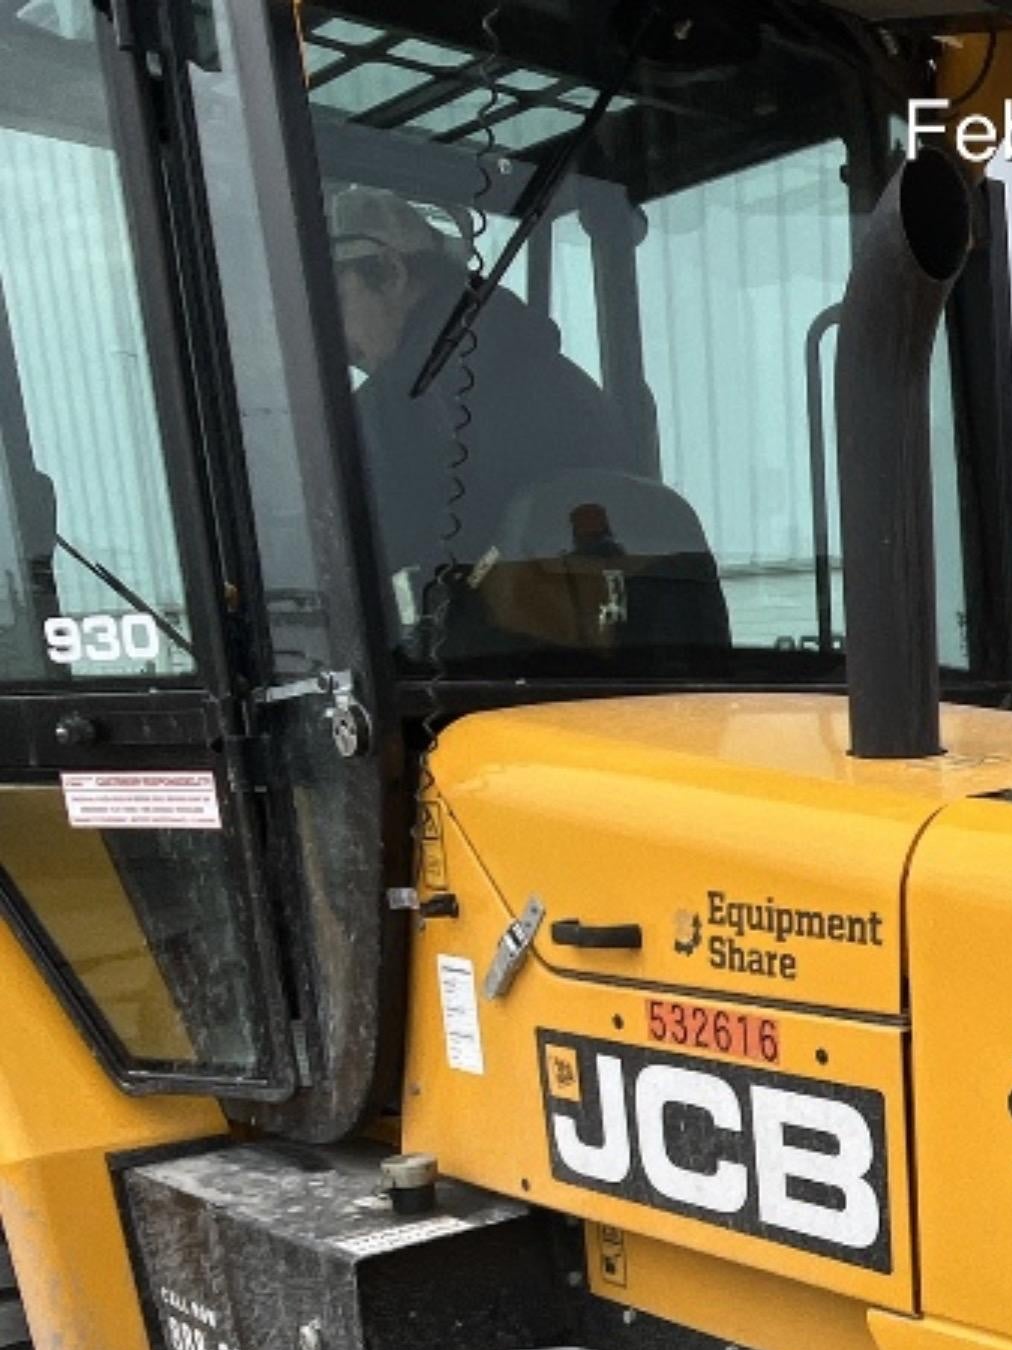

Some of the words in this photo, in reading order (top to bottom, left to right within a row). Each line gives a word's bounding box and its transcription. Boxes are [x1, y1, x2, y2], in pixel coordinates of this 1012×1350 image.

[44, 614, 160, 663] 930
[707, 890, 882, 946] Equipment
[709, 937, 796, 979] Share
[648, 1001, 778, 1062] 532616
[553, 1053, 880, 1249] JCB
